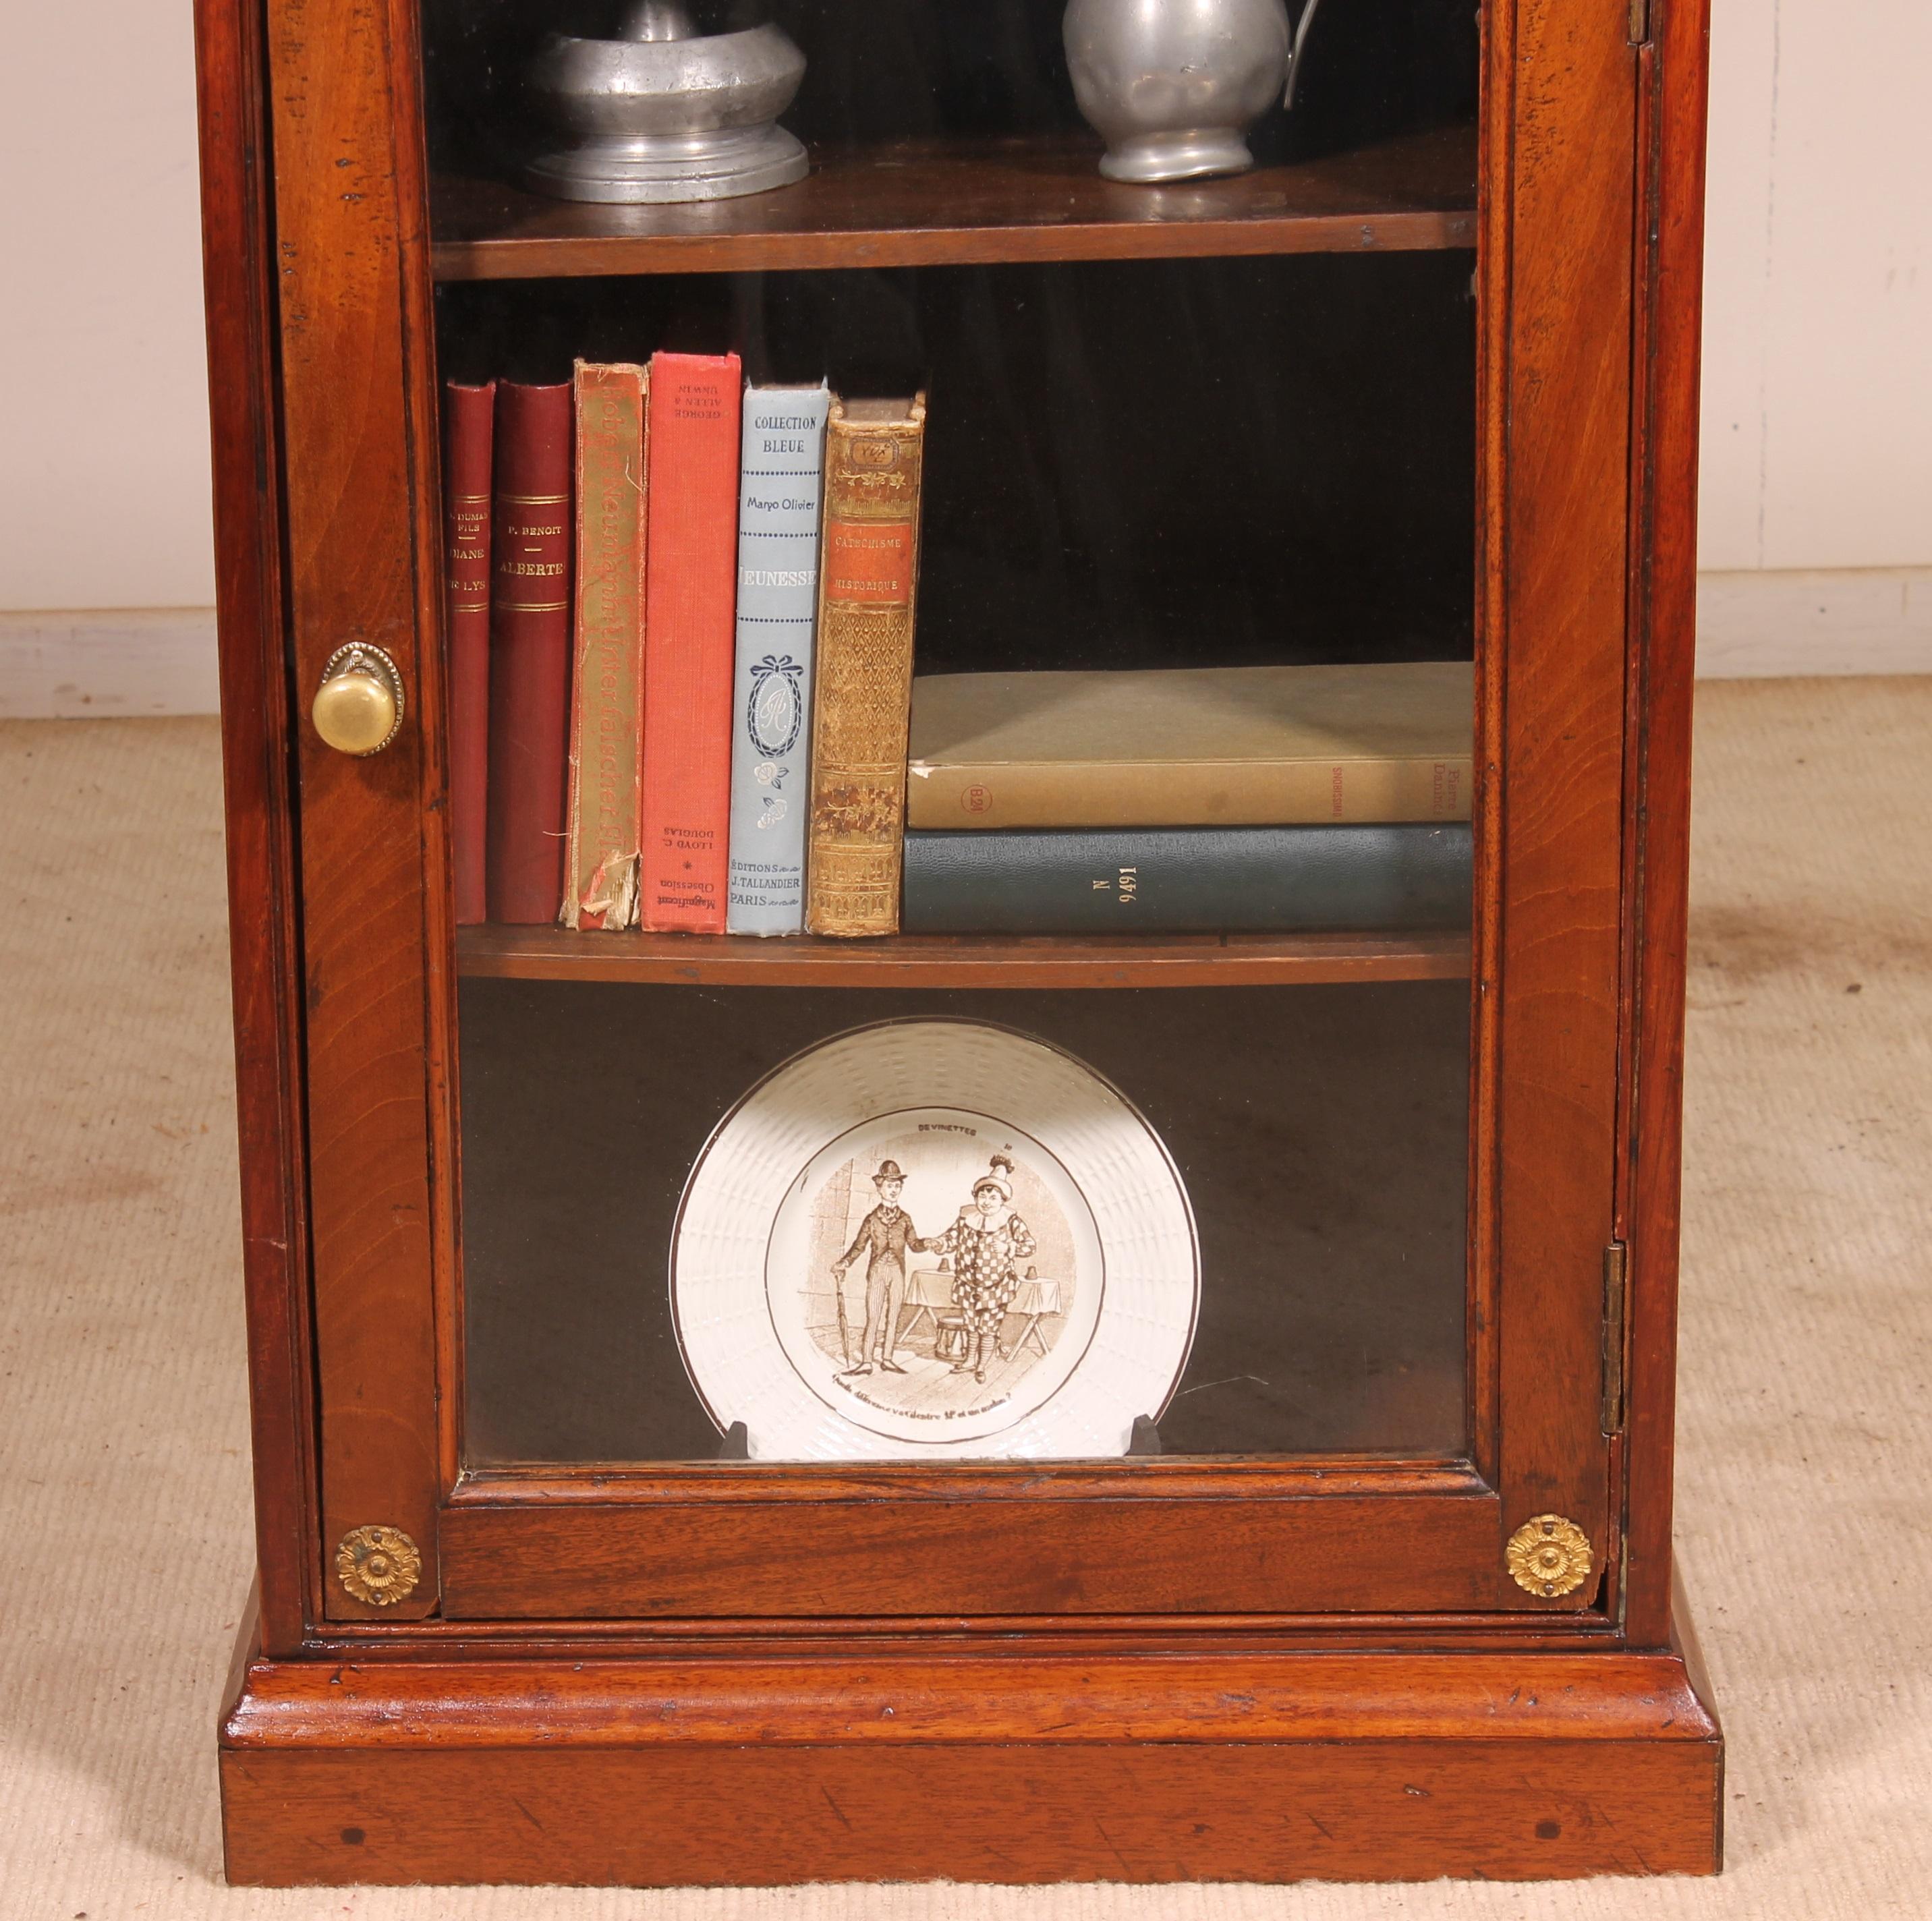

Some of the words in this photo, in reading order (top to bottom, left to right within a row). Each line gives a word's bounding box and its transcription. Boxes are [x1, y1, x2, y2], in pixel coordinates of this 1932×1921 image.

[685, 397, 722, 407] ALLEN
[675, 409, 721, 420] GEORGE
[755, 416, 816, 430] COLLECTION
[763, 438, 804, 453] BLEUE
[782, 498, 816, 511] Olivier
[458, 524, 480, 532] FILS
[508, 525, 517, 535] P.
[522, 526, 562, 536] BENOIT
[500, 562, 564, 576] ALBERTE
[463, 581, 486, 591] LYS
[835, 579, 899, 594] HISTORIQUE
[1332, 766, 1343, 818] SNOBISSIMO
[1447, 768, 1460, 810] Pierre
[664, 827, 714, 838] DOUGLAS
[660, 880, 714, 893] Obsession
[1092, 880, 1110, 890] N
[1118, 866, 1137, 903] 9491
[657, 895, 716, 910] Magnificent
[730, 892, 768, 906] PARIS
[918, 1124, 977, 1137] DEVINETTES
